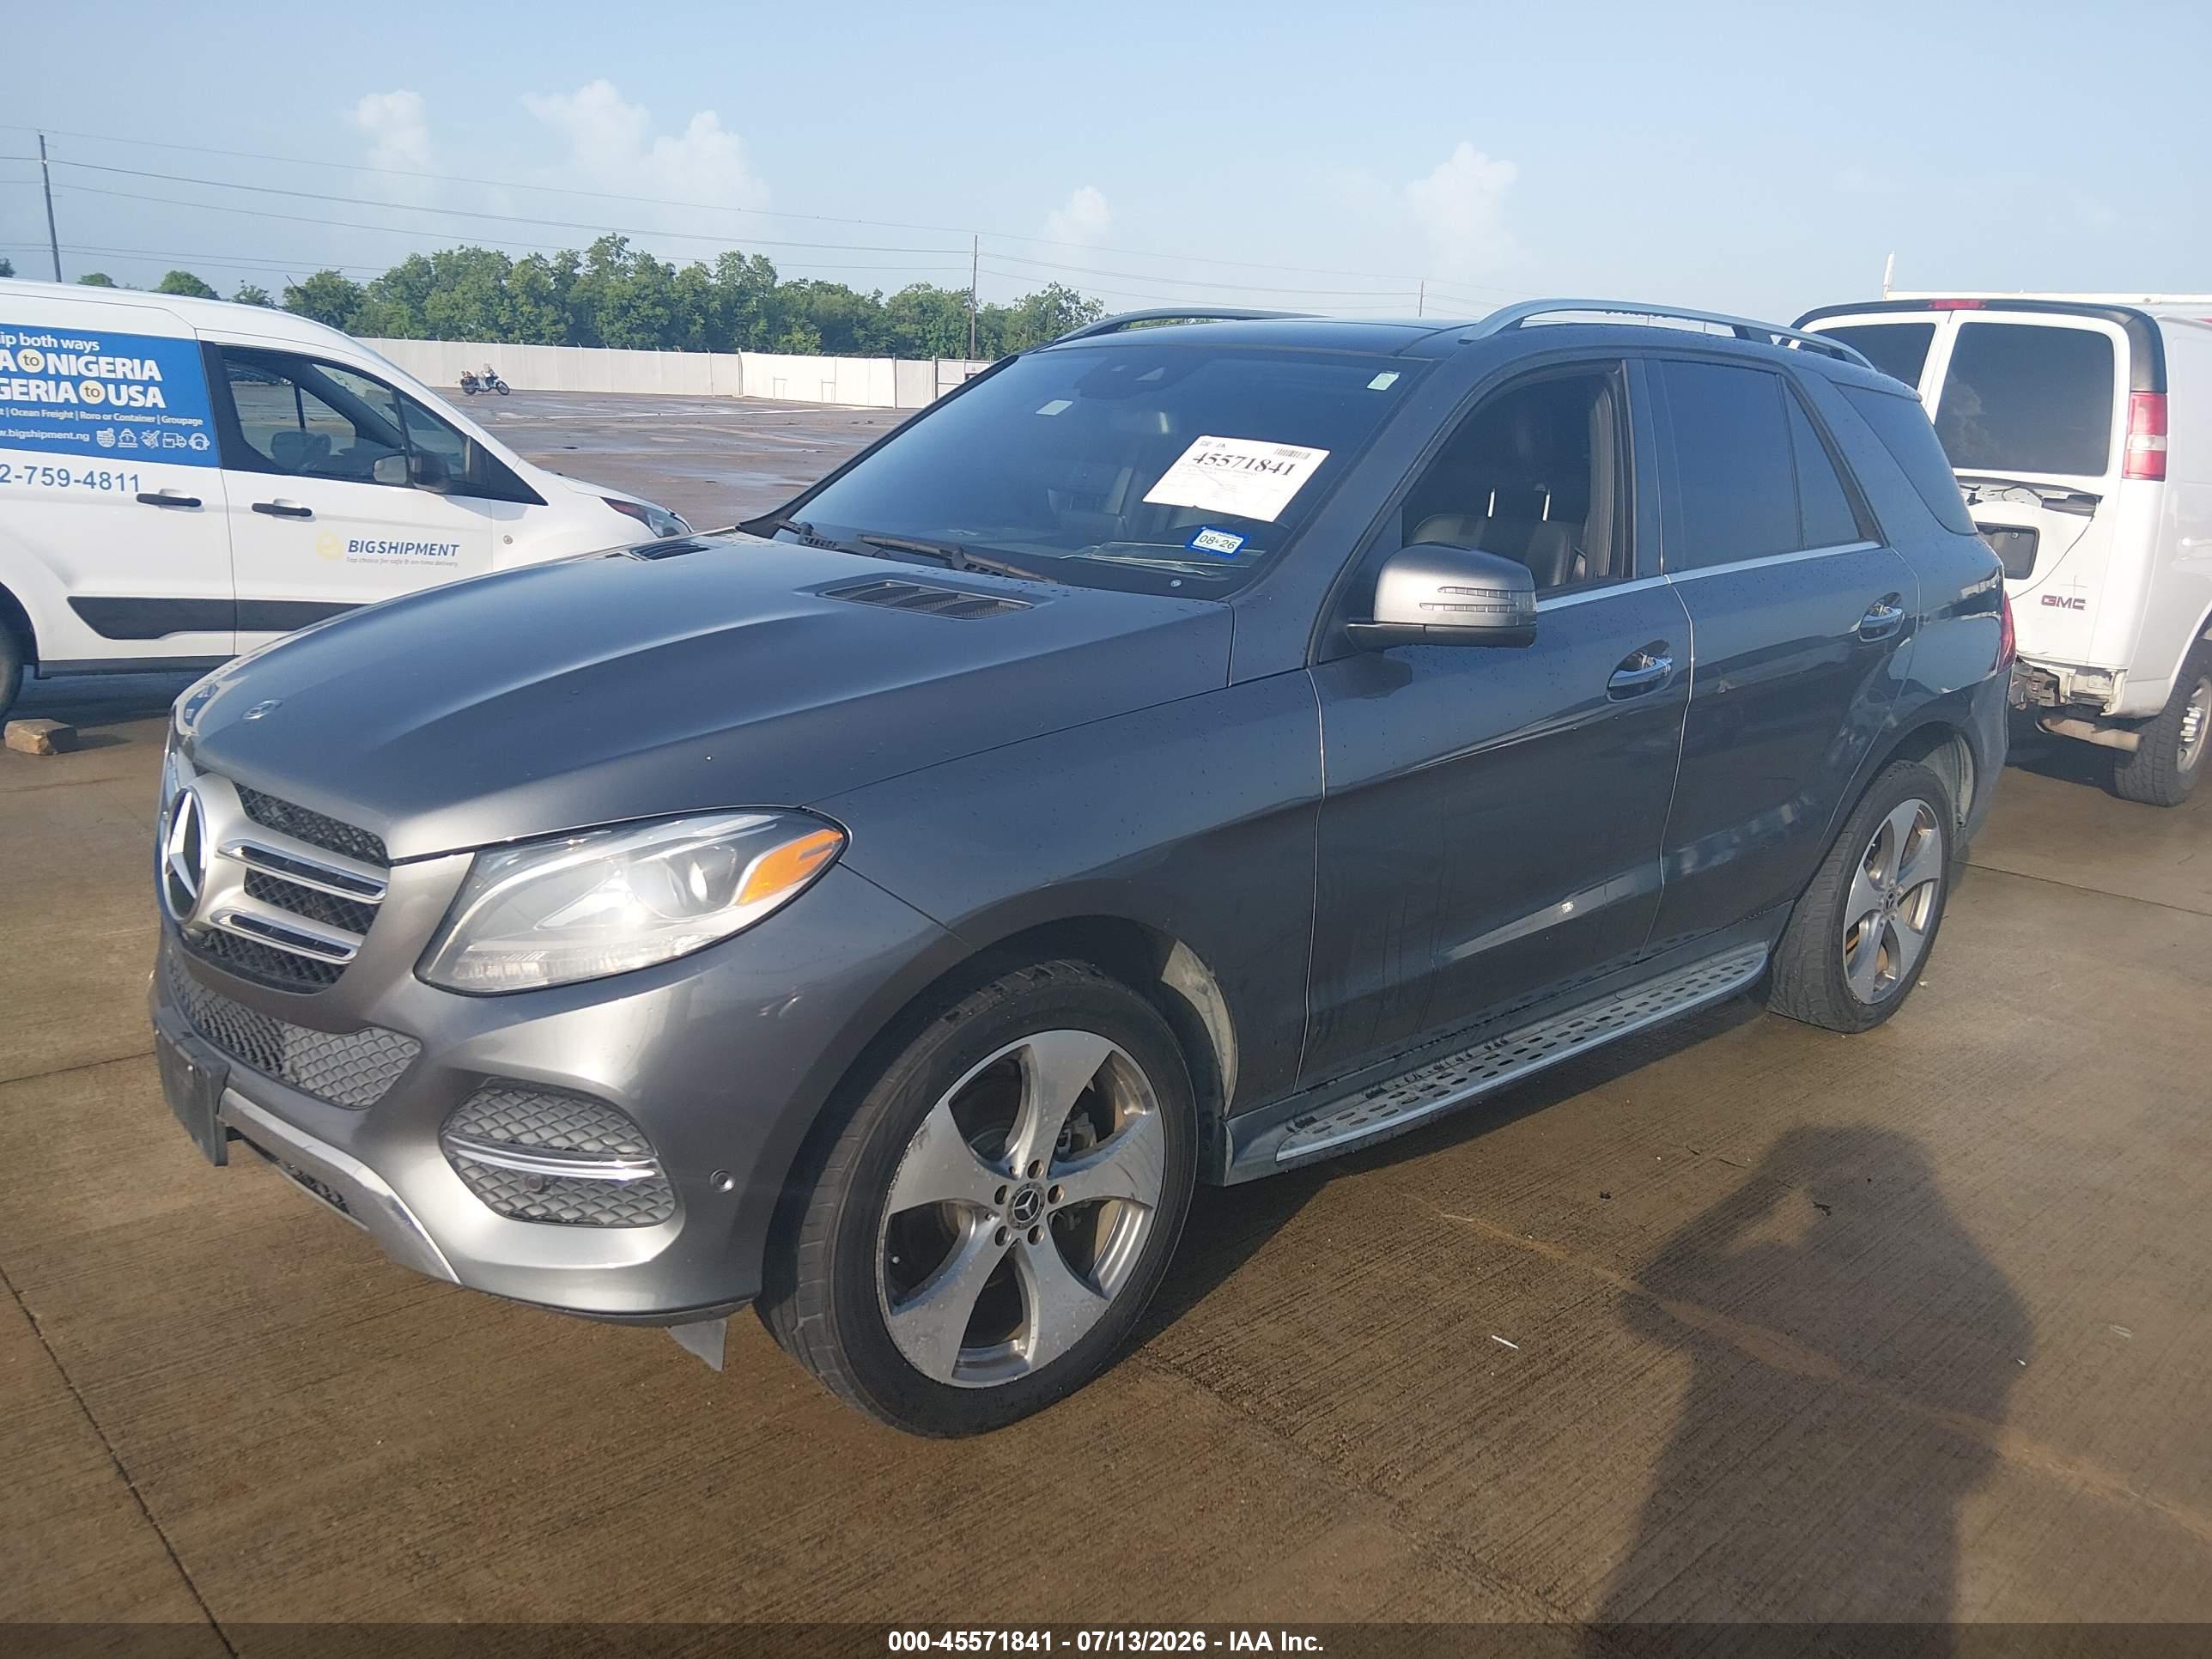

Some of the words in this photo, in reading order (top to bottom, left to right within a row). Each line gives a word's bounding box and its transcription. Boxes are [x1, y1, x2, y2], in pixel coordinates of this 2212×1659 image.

[19, 332, 58, 348] both
[60, 339, 100, 353] ways
[22, 355, 40, 366] to
[46, 353, 162, 381] NIGERIA
[83, 386, 100, 398] to
[107, 384, 166, 408] USA
[10, 408, 40, 417] Ocean
[41, 410, 74, 420] Freight
[80, 411, 101, 420] Roro
[113, 412, 155, 423] Container
[161, 416, 204, 426] Groupage
[1192, 452, 1296, 476] 45571841
[0, 464, 139, 492] 2-759-4811
[348, 539, 460, 557] BIGSHIPMENT
[2041, 594, 2087, 611] GMC
